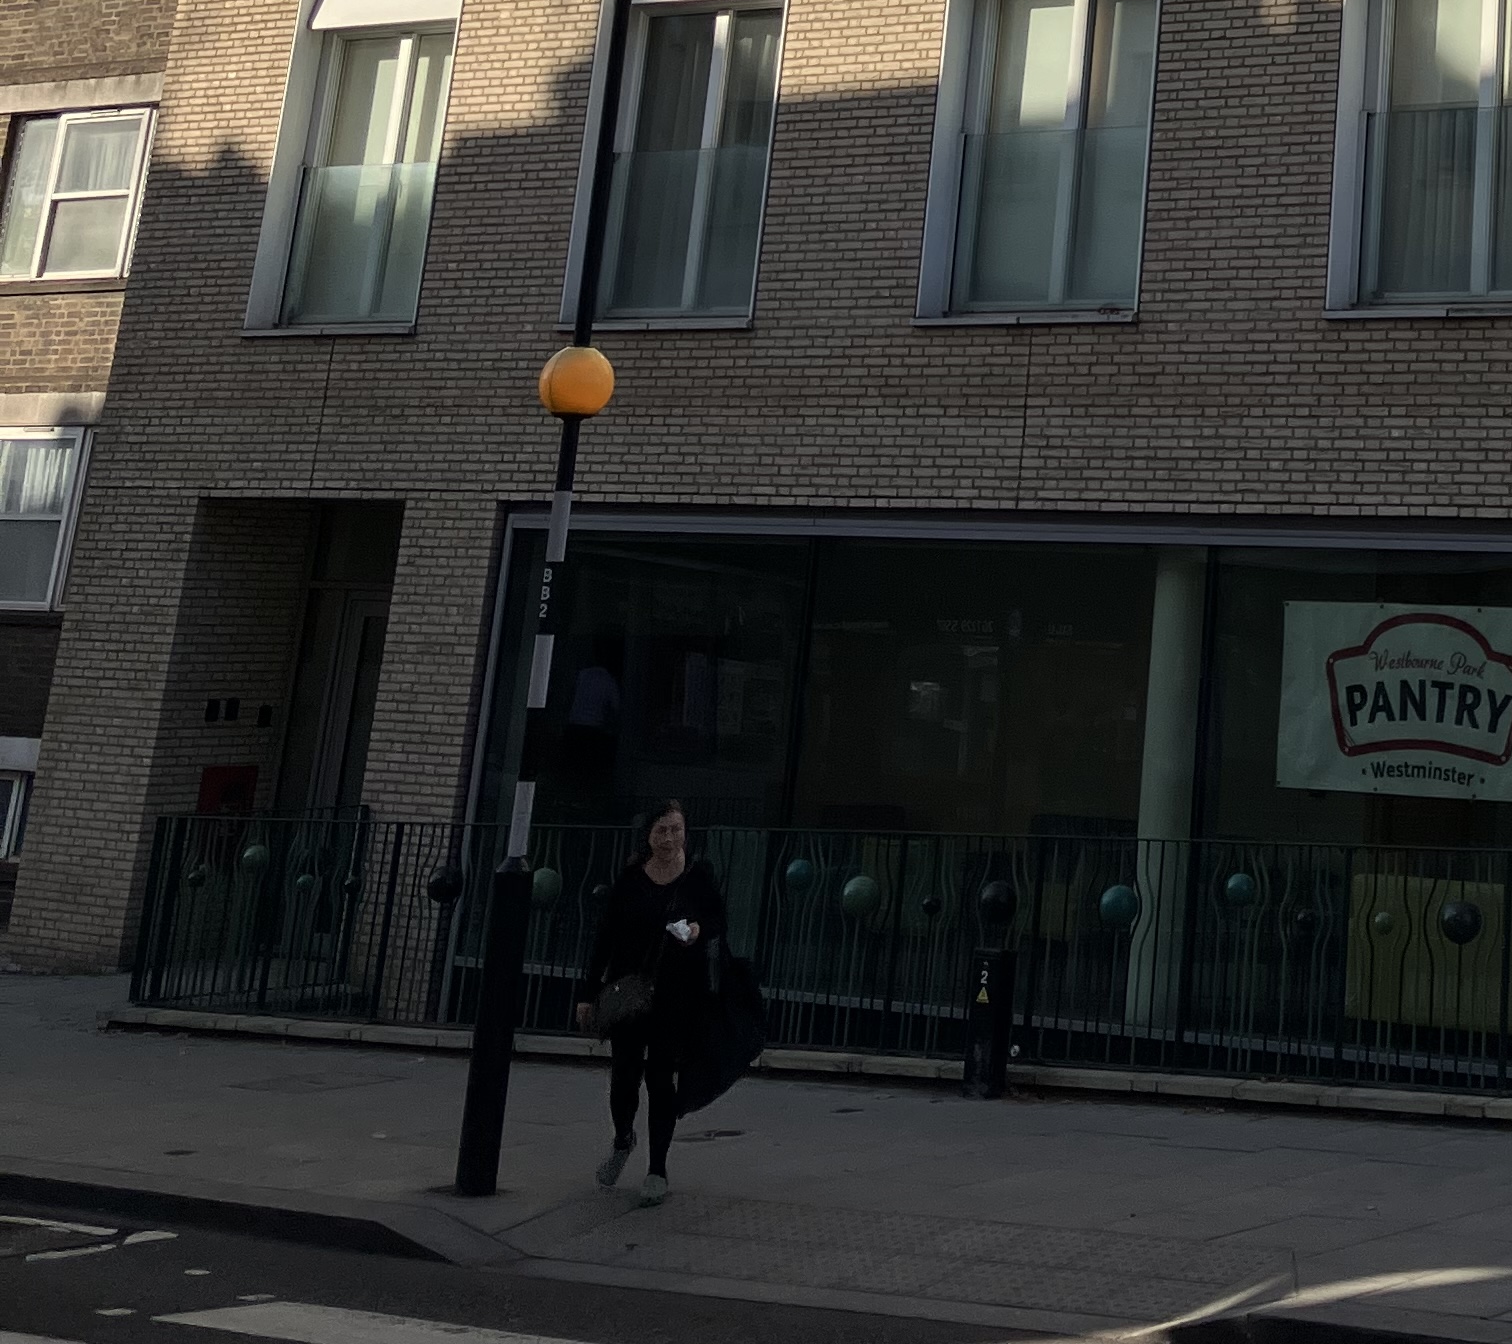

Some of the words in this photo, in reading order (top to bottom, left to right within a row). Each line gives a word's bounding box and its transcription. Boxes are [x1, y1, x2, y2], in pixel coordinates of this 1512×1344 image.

[1369, 649, 1444, 671] Westbourne
[1446, 651, 1487, 680] Park
[1371, 761, 1475, 787] Westminster
